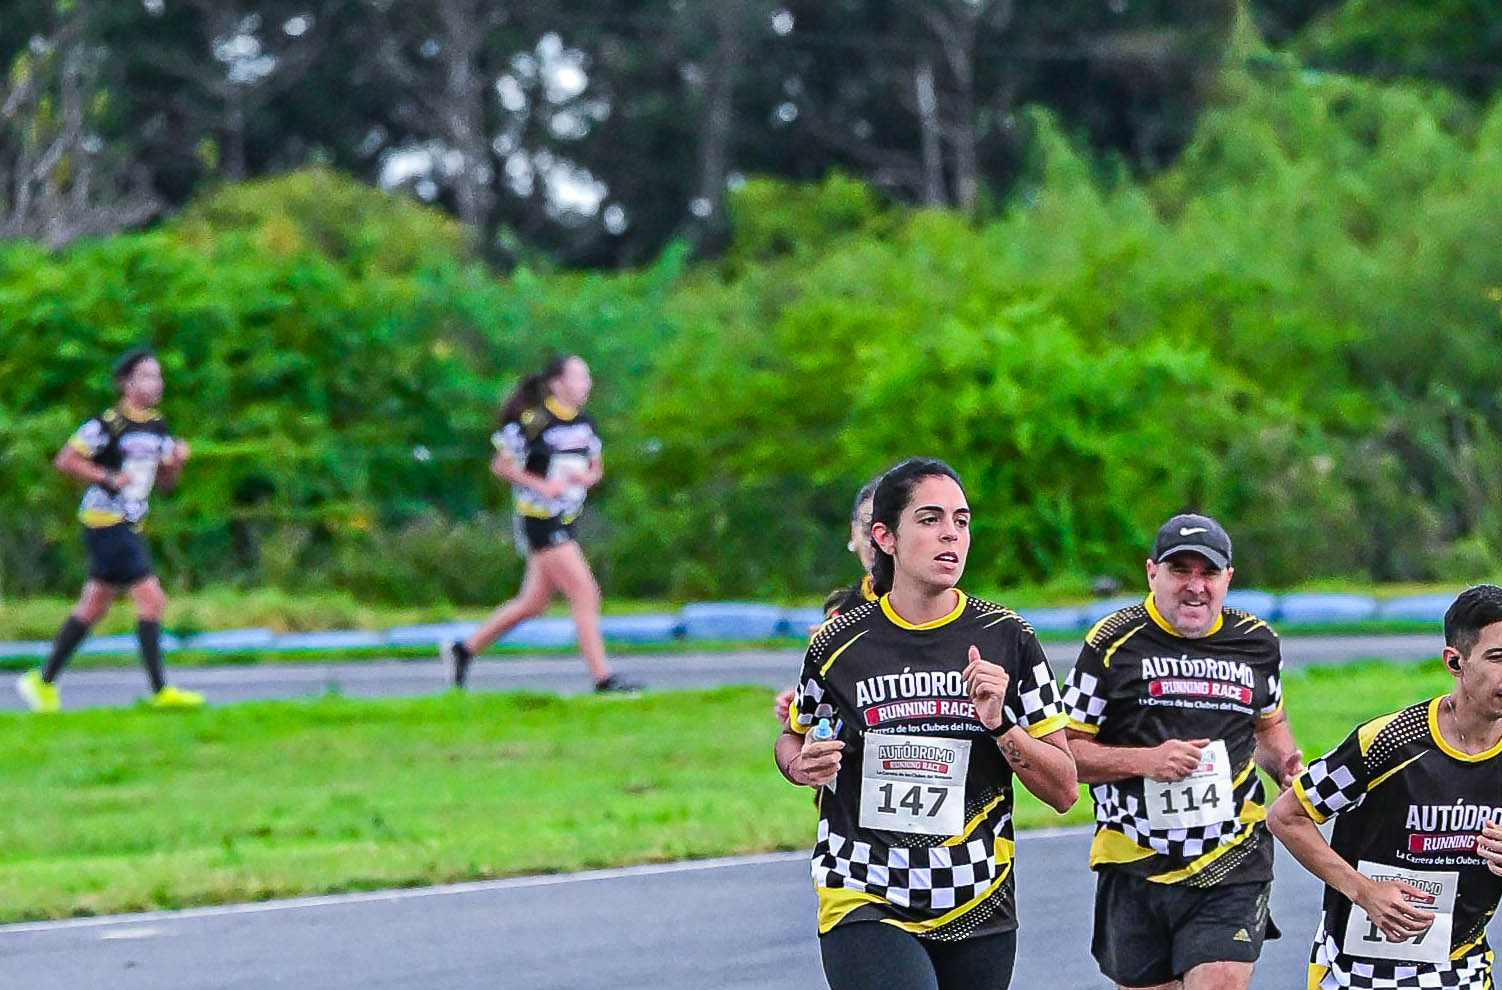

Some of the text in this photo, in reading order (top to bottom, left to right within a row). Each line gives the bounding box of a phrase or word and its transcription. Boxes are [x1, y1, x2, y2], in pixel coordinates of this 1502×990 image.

[1141, 654, 1254, 688] AUTÓDROMO
[856, 667, 969, 708] AUTÓDRO
[1161, 681, 1242, 701] RUNNING RACE
[877, 701, 976, 721] RUNNING RACE
[896, 724, 907, 733] de
[908, 724, 920, 732] los
[921, 723, 950, 732] Clubes
[950, 723, 964, 731] del
[879, 741, 955, 763] AUTÓDROMO
[877, 783, 949, 817] 147
[1160, 784, 1220, 814] 114
[1423, 835, 1476, 851] RUNNING
[1396, 849, 1405, 859] La
[1406, 853, 1433, 864] Carrera
[1434, 856, 1444, 864] de
[1445, 856, 1455, 864] los
[1456, 856, 1480, 864] Clubes
[1362, 915, 1434, 944] 17
